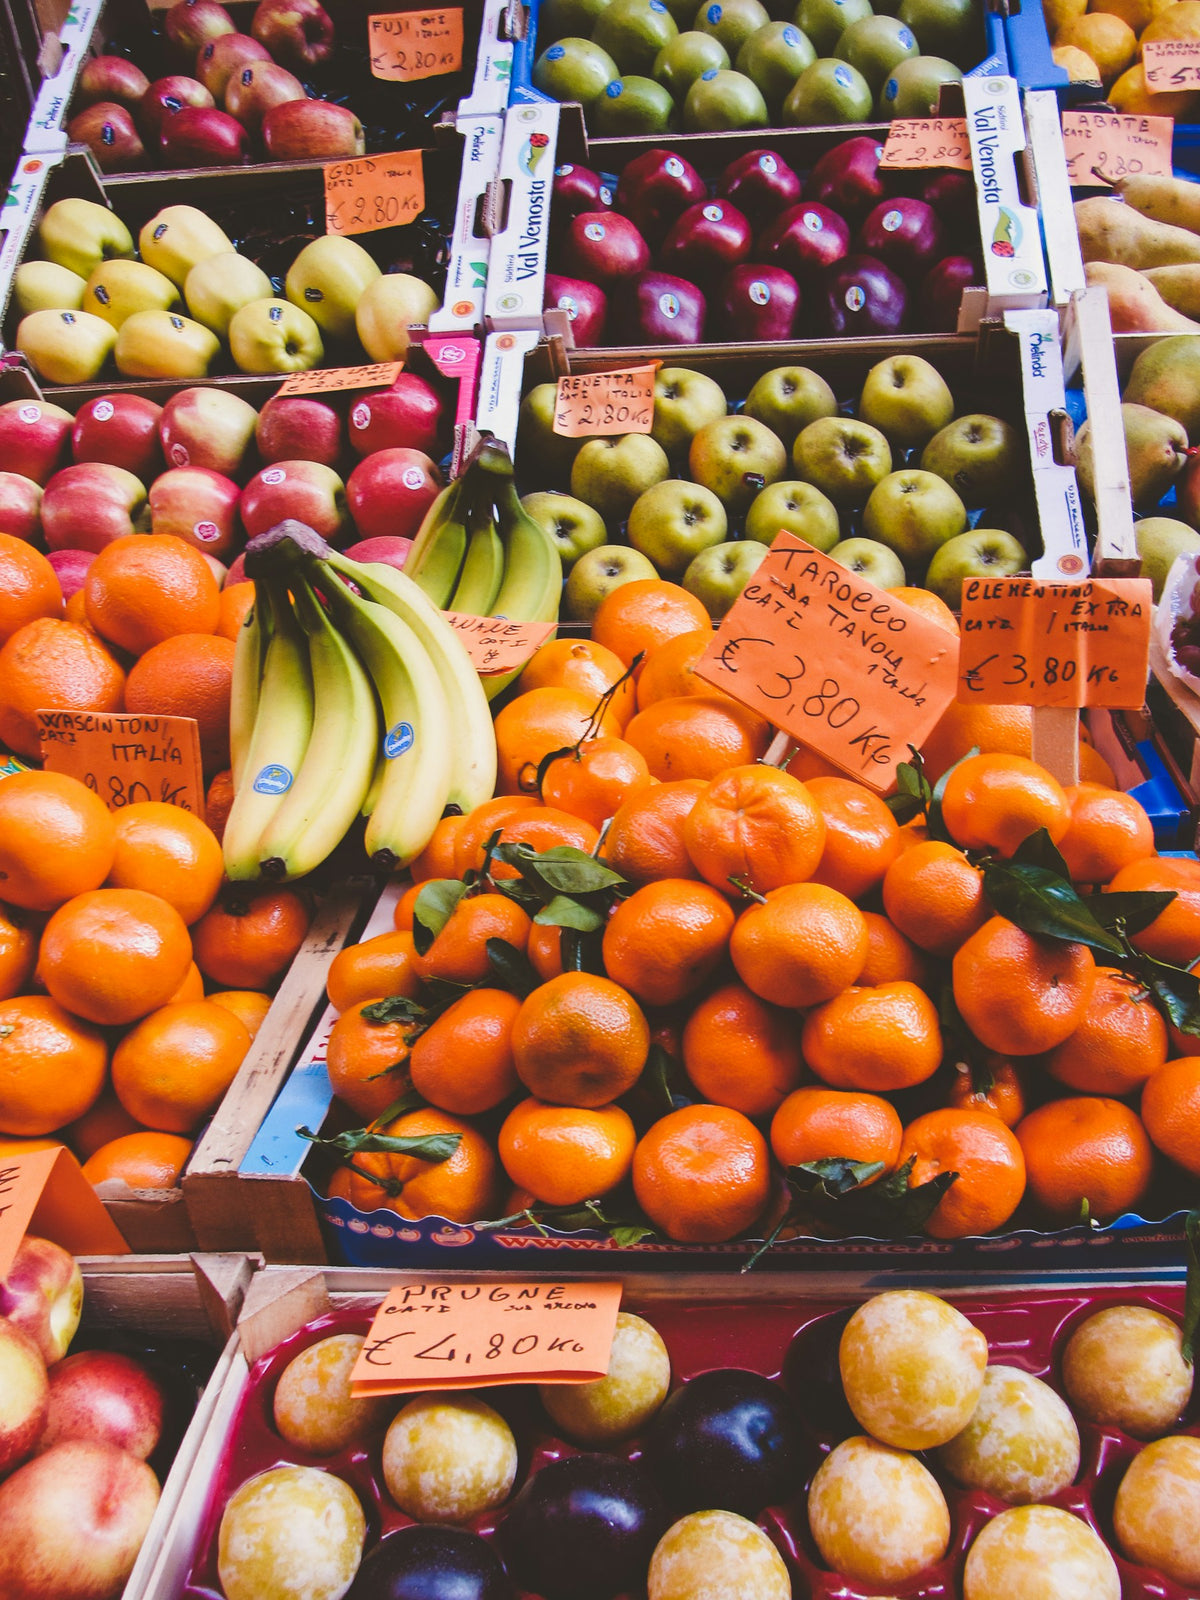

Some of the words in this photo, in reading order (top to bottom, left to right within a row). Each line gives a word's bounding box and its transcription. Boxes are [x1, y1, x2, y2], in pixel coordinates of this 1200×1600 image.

[373, 21, 410, 36] FUJI
[1147, 66, 1164, 82] €
[892, 121, 963, 132] STARK
[974, 106, 997, 132] Val
[1079, 115, 1149, 132] ABATE
[329, 160, 376, 179] GOLD
[977, 135, 1003, 204] Venosta
[327, 201, 345, 230] €
[519, 180, 545, 249] Venosta
[516, 252, 539, 281] Val
[562, 374, 634, 391] RENETTA
[771, 548, 907, 632] TAROCCO
[966, 581, 1094, 601] CLEMENTINO
[448, 616, 523, 635] ANANE
[827, 603, 903, 671] TAVOLA
[713, 637, 776, 672] €
[960, 654, 999, 691] €
[111, 738, 182, 764] ITALIA
[401, 1285, 567, 1304] PRUGNE
[363, 1331, 417, 1365] €
[414, 1333, 539, 1364] 4,80
